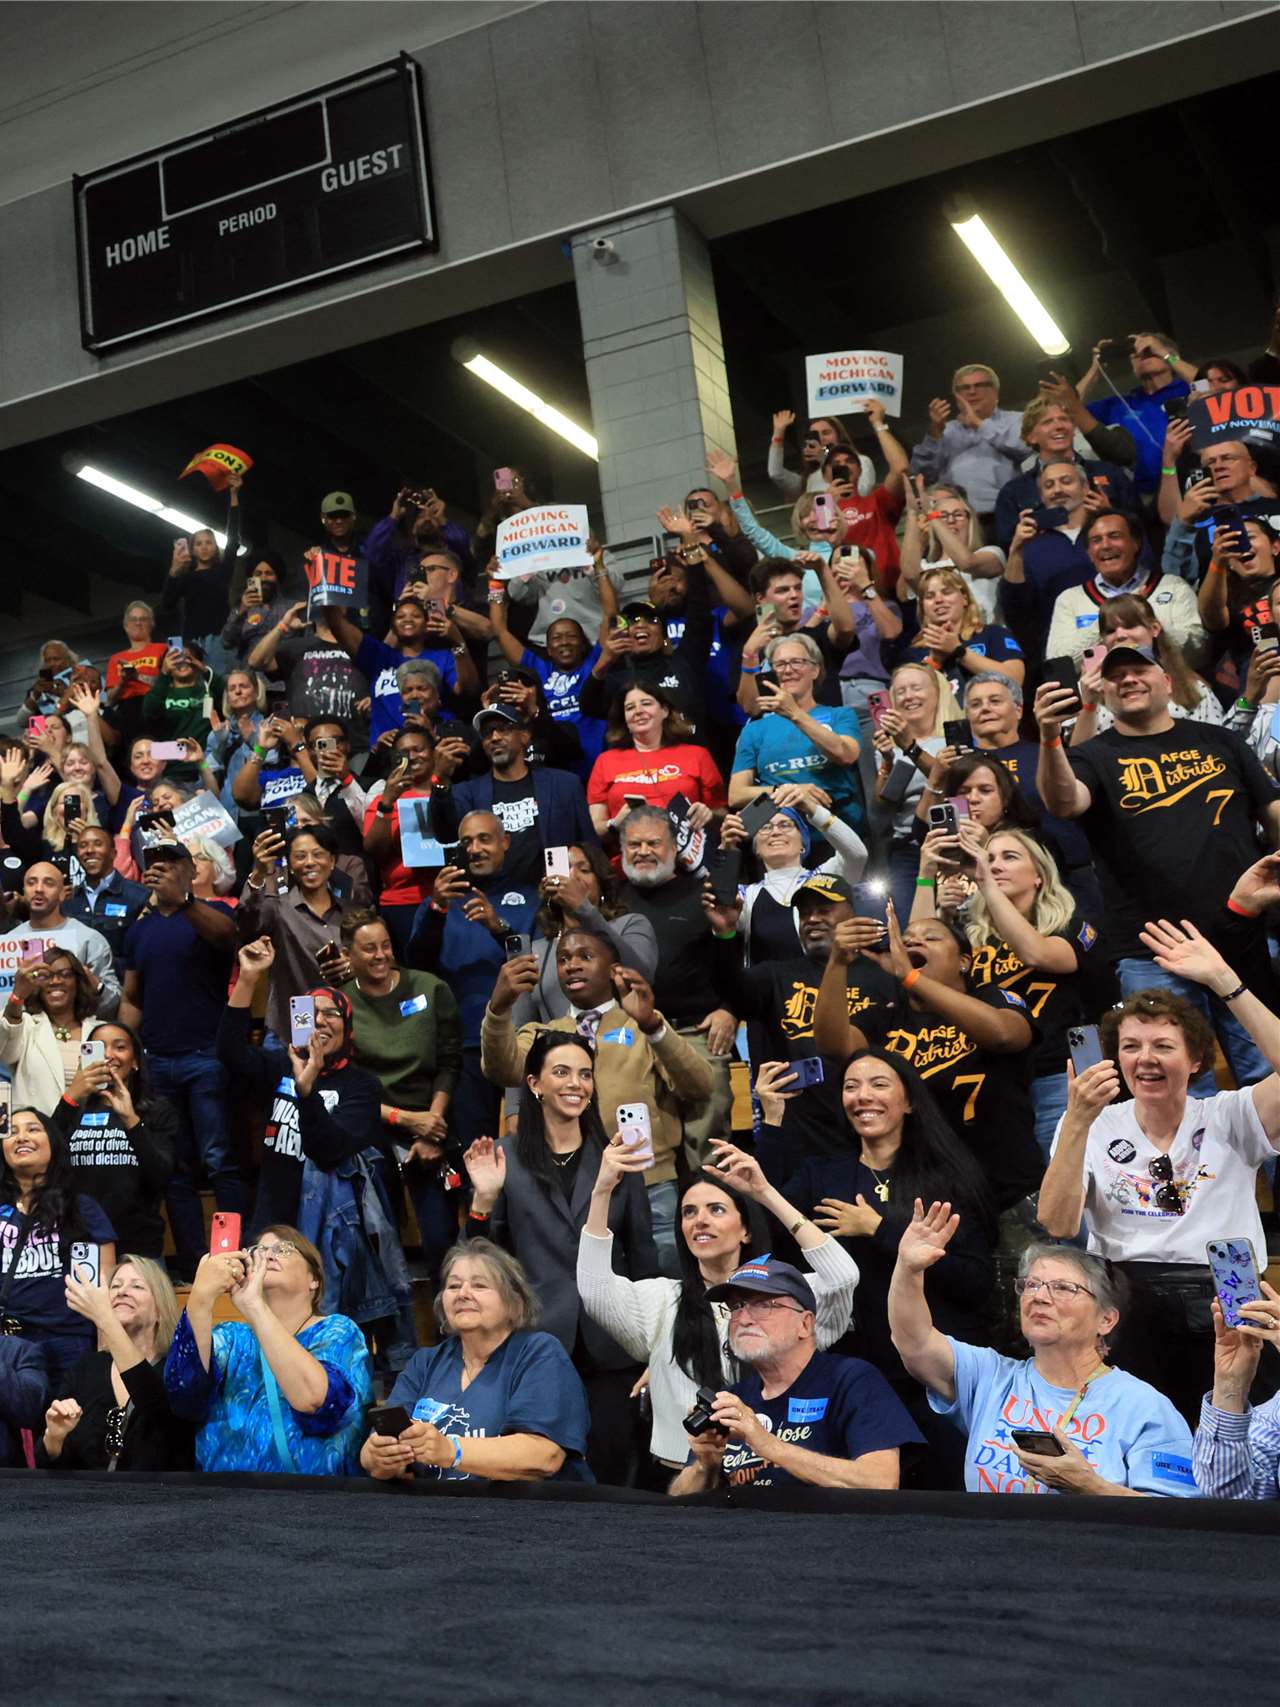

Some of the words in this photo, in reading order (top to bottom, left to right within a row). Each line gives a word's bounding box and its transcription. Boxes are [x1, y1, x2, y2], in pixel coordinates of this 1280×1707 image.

[321, 144, 403, 193] GUEST
[219, 203, 277, 236] PERIOD
[106, 226, 170, 268] HOME
[826, 356, 888, 368] MOVING
[819, 368, 895, 381] MICHIGAN
[818, 382, 896, 398] FORWARD
[1205, 386, 1280, 425] VOT
[1211, 423, 1229, 434] BY
[1229, 419, 1280, 432] NOVEM
[509, 510, 569, 528] MOVING
[502, 522, 578, 543] MICHIGAN
[502, 536, 581, 559] FORWARD
[303, 650, 351, 660] RAMON
[1160, 749, 1201, 765] AFGE
[1119, 757, 1221, 800] District
[1205, 789, 1235, 826] 7
[1025, 983, 1057, 1019] 7
[919, 1025, 957, 1044] AFGE
[884, 1028, 971, 1068] District
[952, 1073, 986, 1122] 7
[104, 1128, 128, 1138] bein
[96, 1140, 105, 1151] of
[80, 1153, 95, 1165] not
